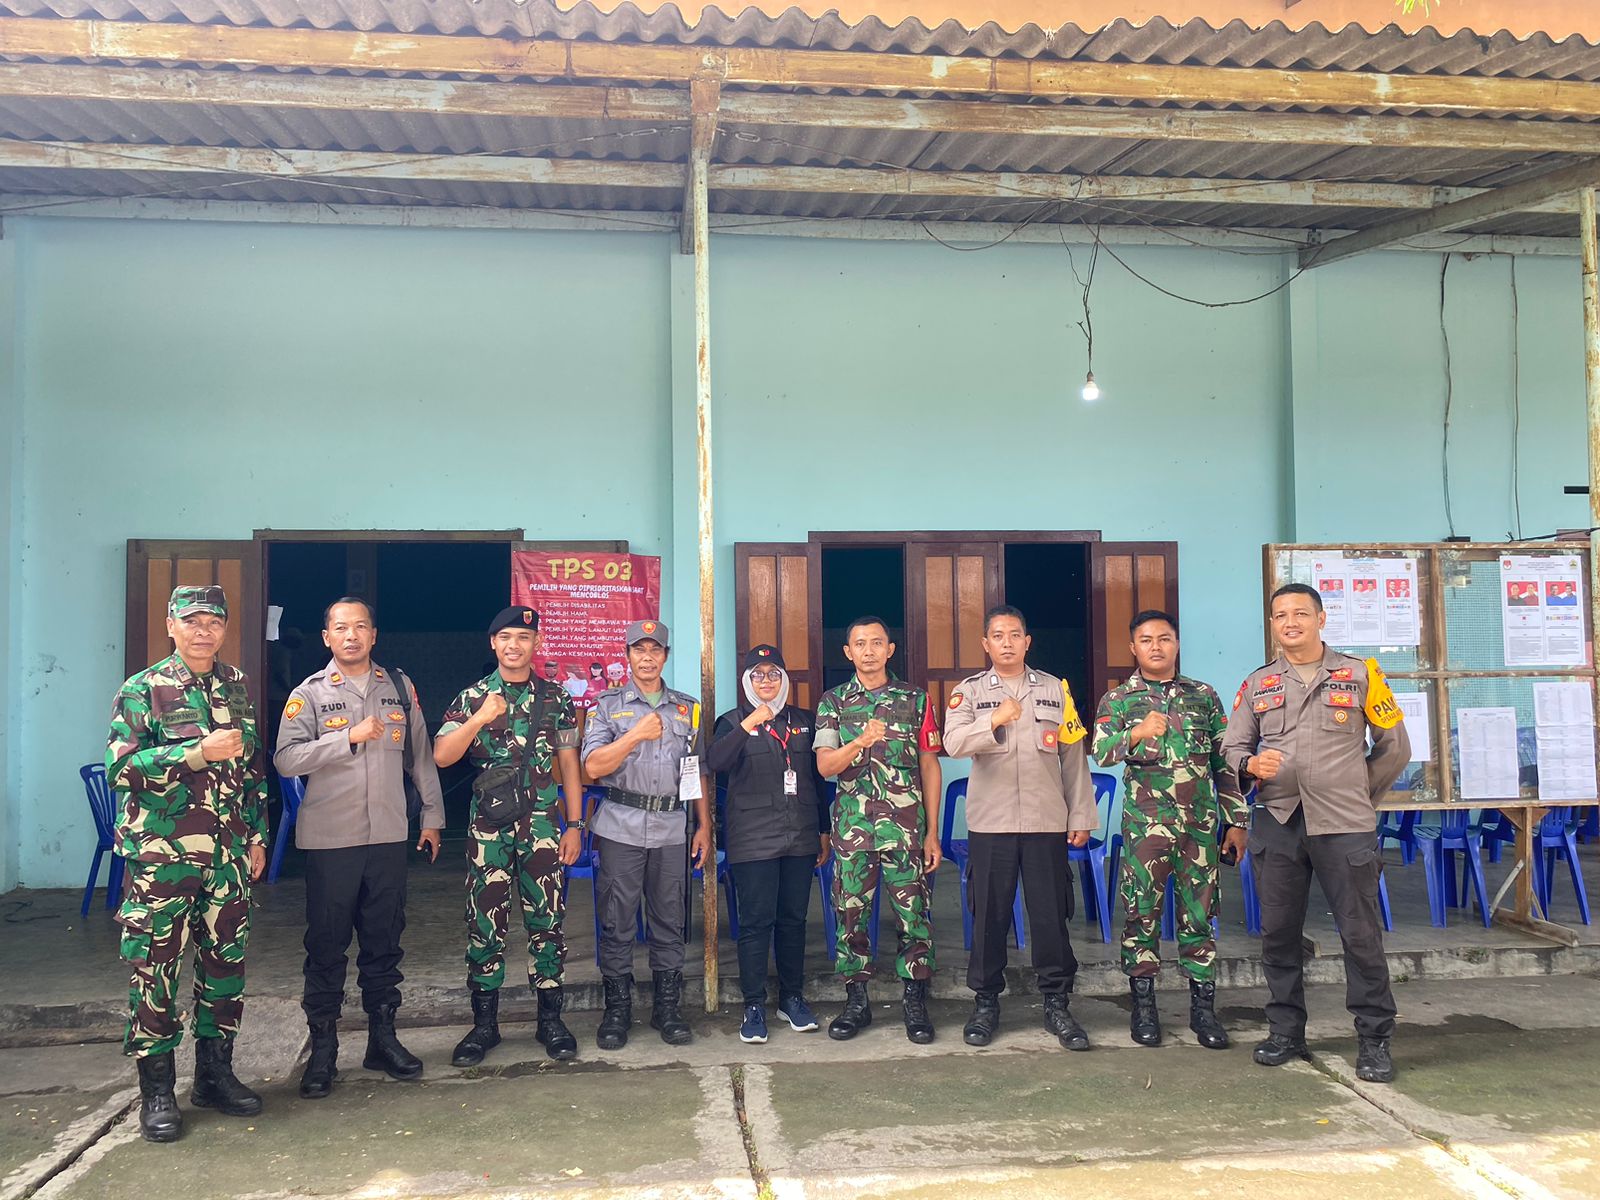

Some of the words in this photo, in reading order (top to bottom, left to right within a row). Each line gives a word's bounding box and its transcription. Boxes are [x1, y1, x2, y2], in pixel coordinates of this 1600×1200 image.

[547, 558, 595, 580] TPS
[604, 561, 633, 581] 03
[529, 583, 558, 591] PEMILIH
[570, 591, 609, 599] MENCOBLOS
[1321, 682, 1358, 692] POLRI
[320, 702, 347, 713] ZUDI
[1035, 699, 1060, 708] POLRI
